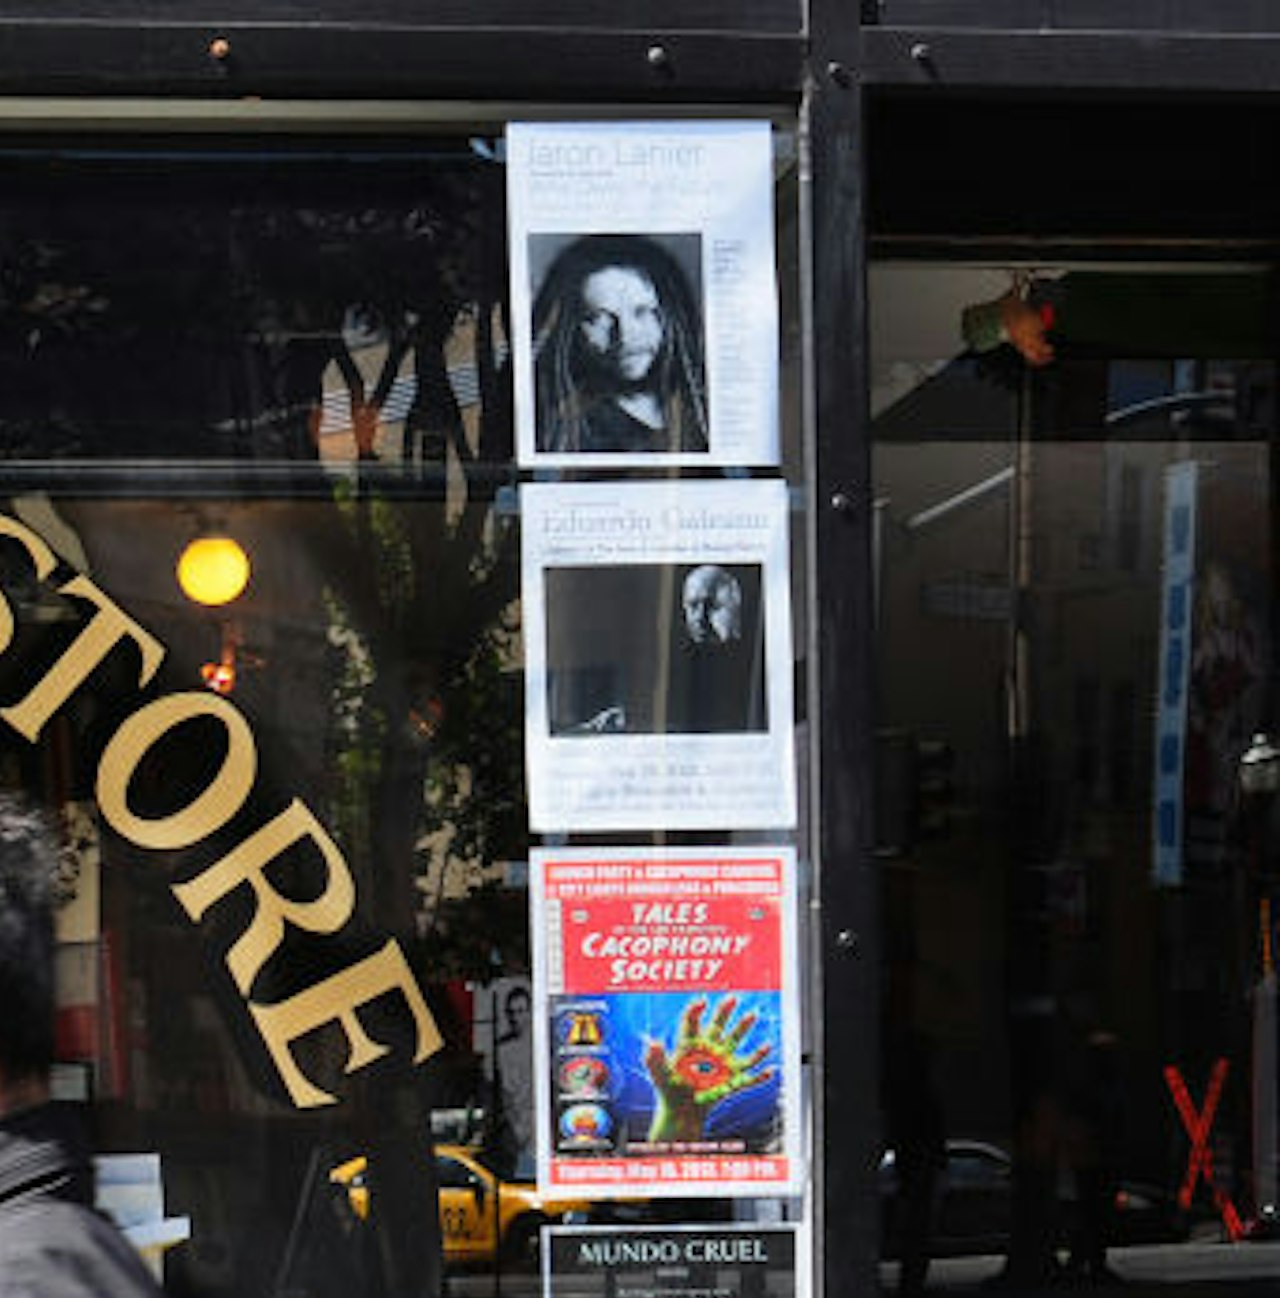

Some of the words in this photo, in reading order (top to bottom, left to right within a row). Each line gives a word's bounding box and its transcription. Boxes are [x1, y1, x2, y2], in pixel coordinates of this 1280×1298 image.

[614, 138, 704, 168] Lanier
[630, 902, 709, 925] TALES
[581, 931, 752, 958] CACOPHONY
[609, 957, 724, 984] SOCIETY
[578, 1240, 680, 1265] MUNDO
[685, 1239, 769, 1263] CRUEL
